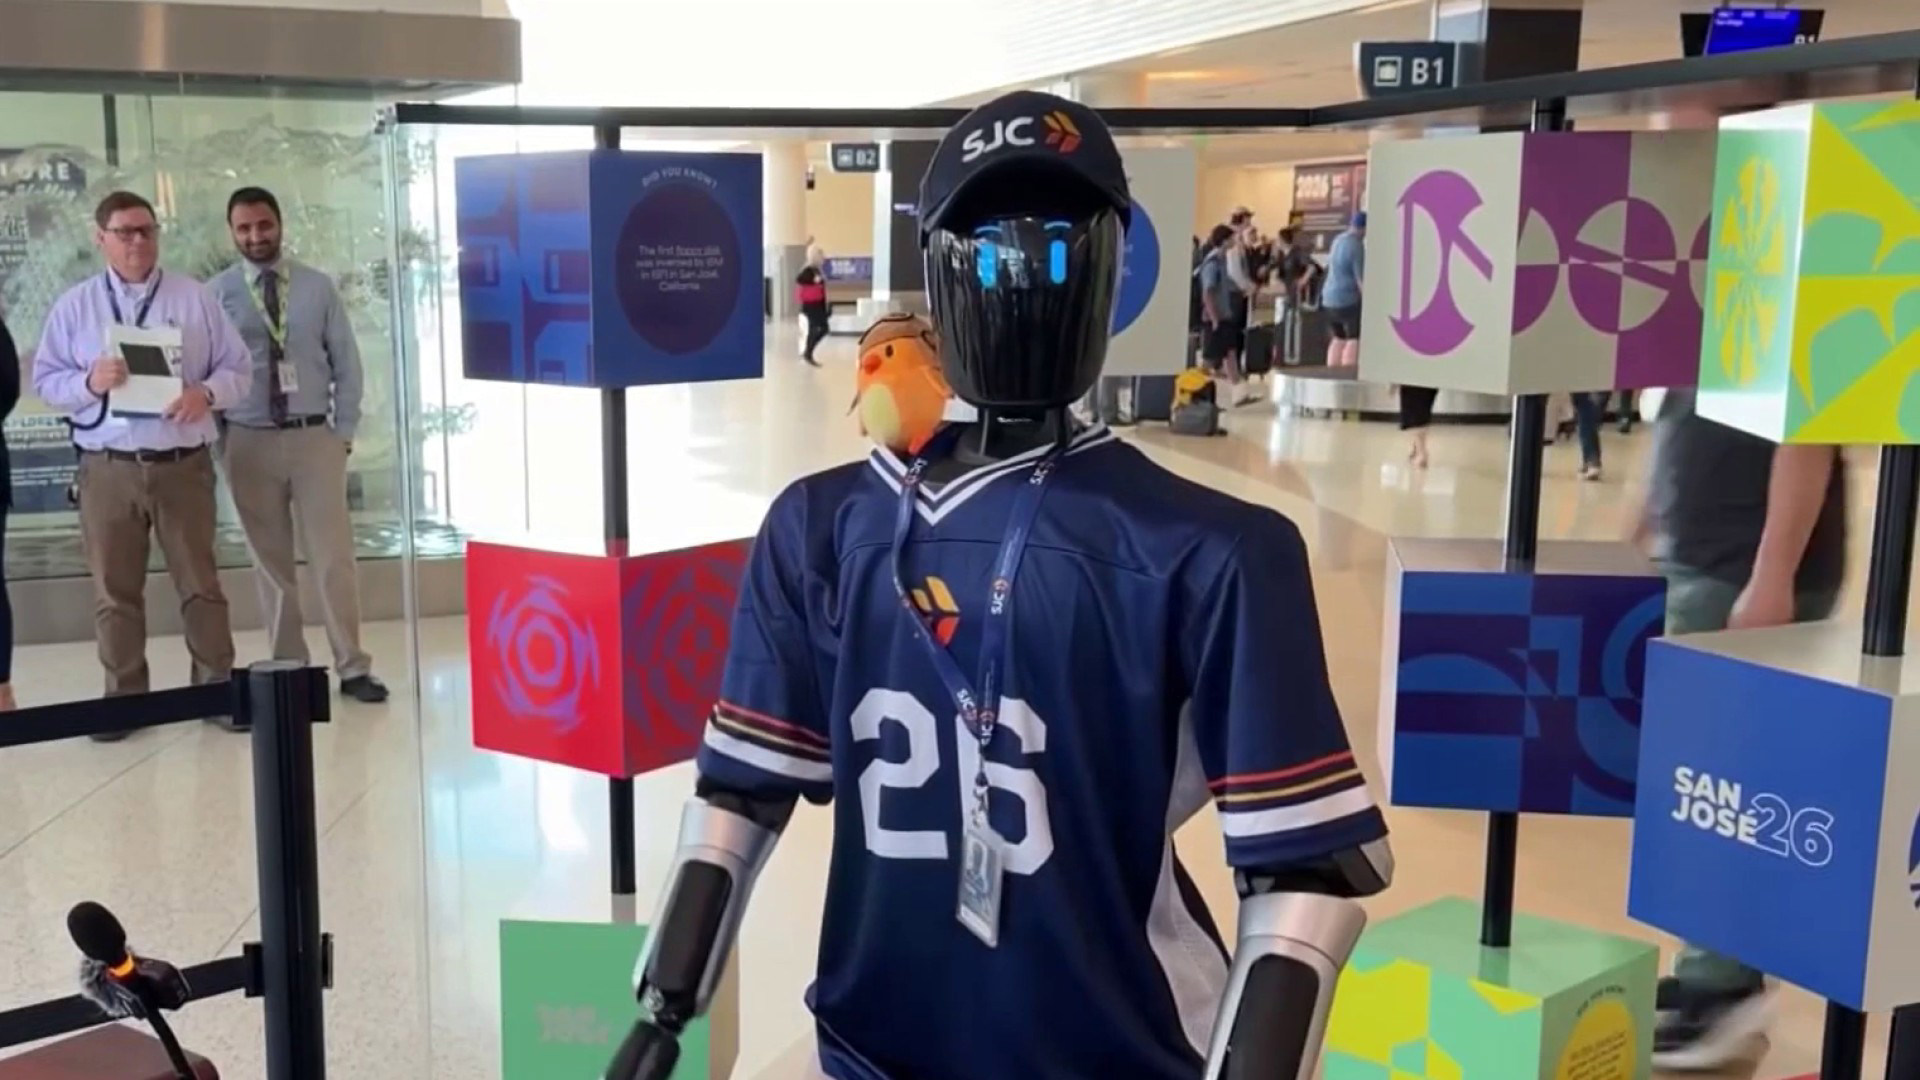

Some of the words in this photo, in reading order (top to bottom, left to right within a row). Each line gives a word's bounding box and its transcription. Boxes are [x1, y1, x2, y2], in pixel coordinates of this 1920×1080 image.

[1411, 57, 1444, 85] B1
[962, 116, 1035, 162] SJC
[856, 148, 876, 166] B2
[661, 167, 681, 178] YOU
[991, 590, 1006, 615] SJC
[957, 688, 976, 711] SJC
[850, 687, 1054, 876] 26
[1673, 766, 1742, 811] SAN
[1671, 796, 1759, 845] JOSÉ
[1750, 792, 1834, 866] 26
